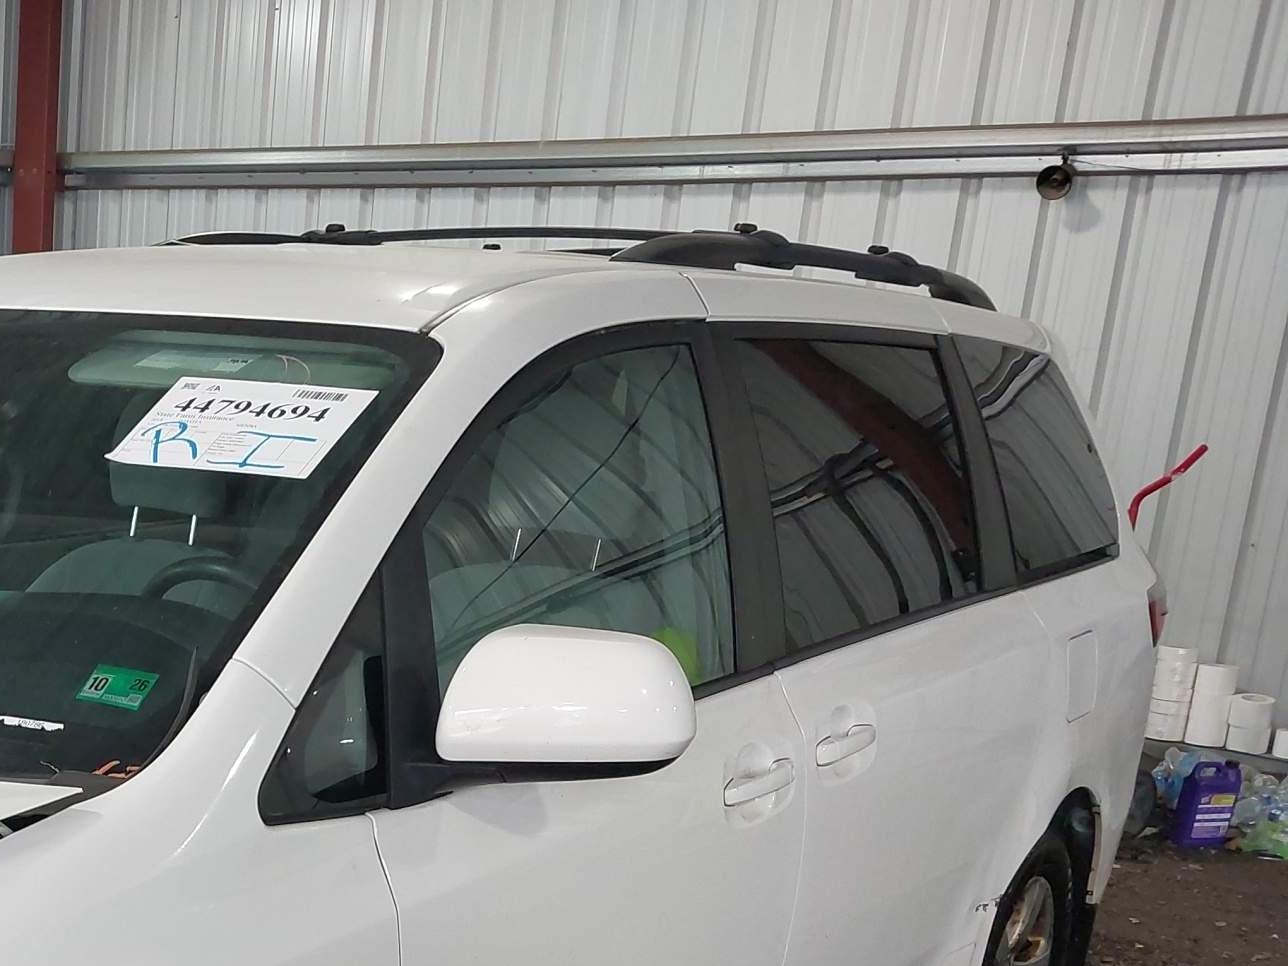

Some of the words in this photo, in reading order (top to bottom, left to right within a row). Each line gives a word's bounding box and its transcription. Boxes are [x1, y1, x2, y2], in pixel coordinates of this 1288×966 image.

[174, 397, 330, 422] 44794694
[88, 676, 109, 691] 10
[129, 678, 150, 691] 26
